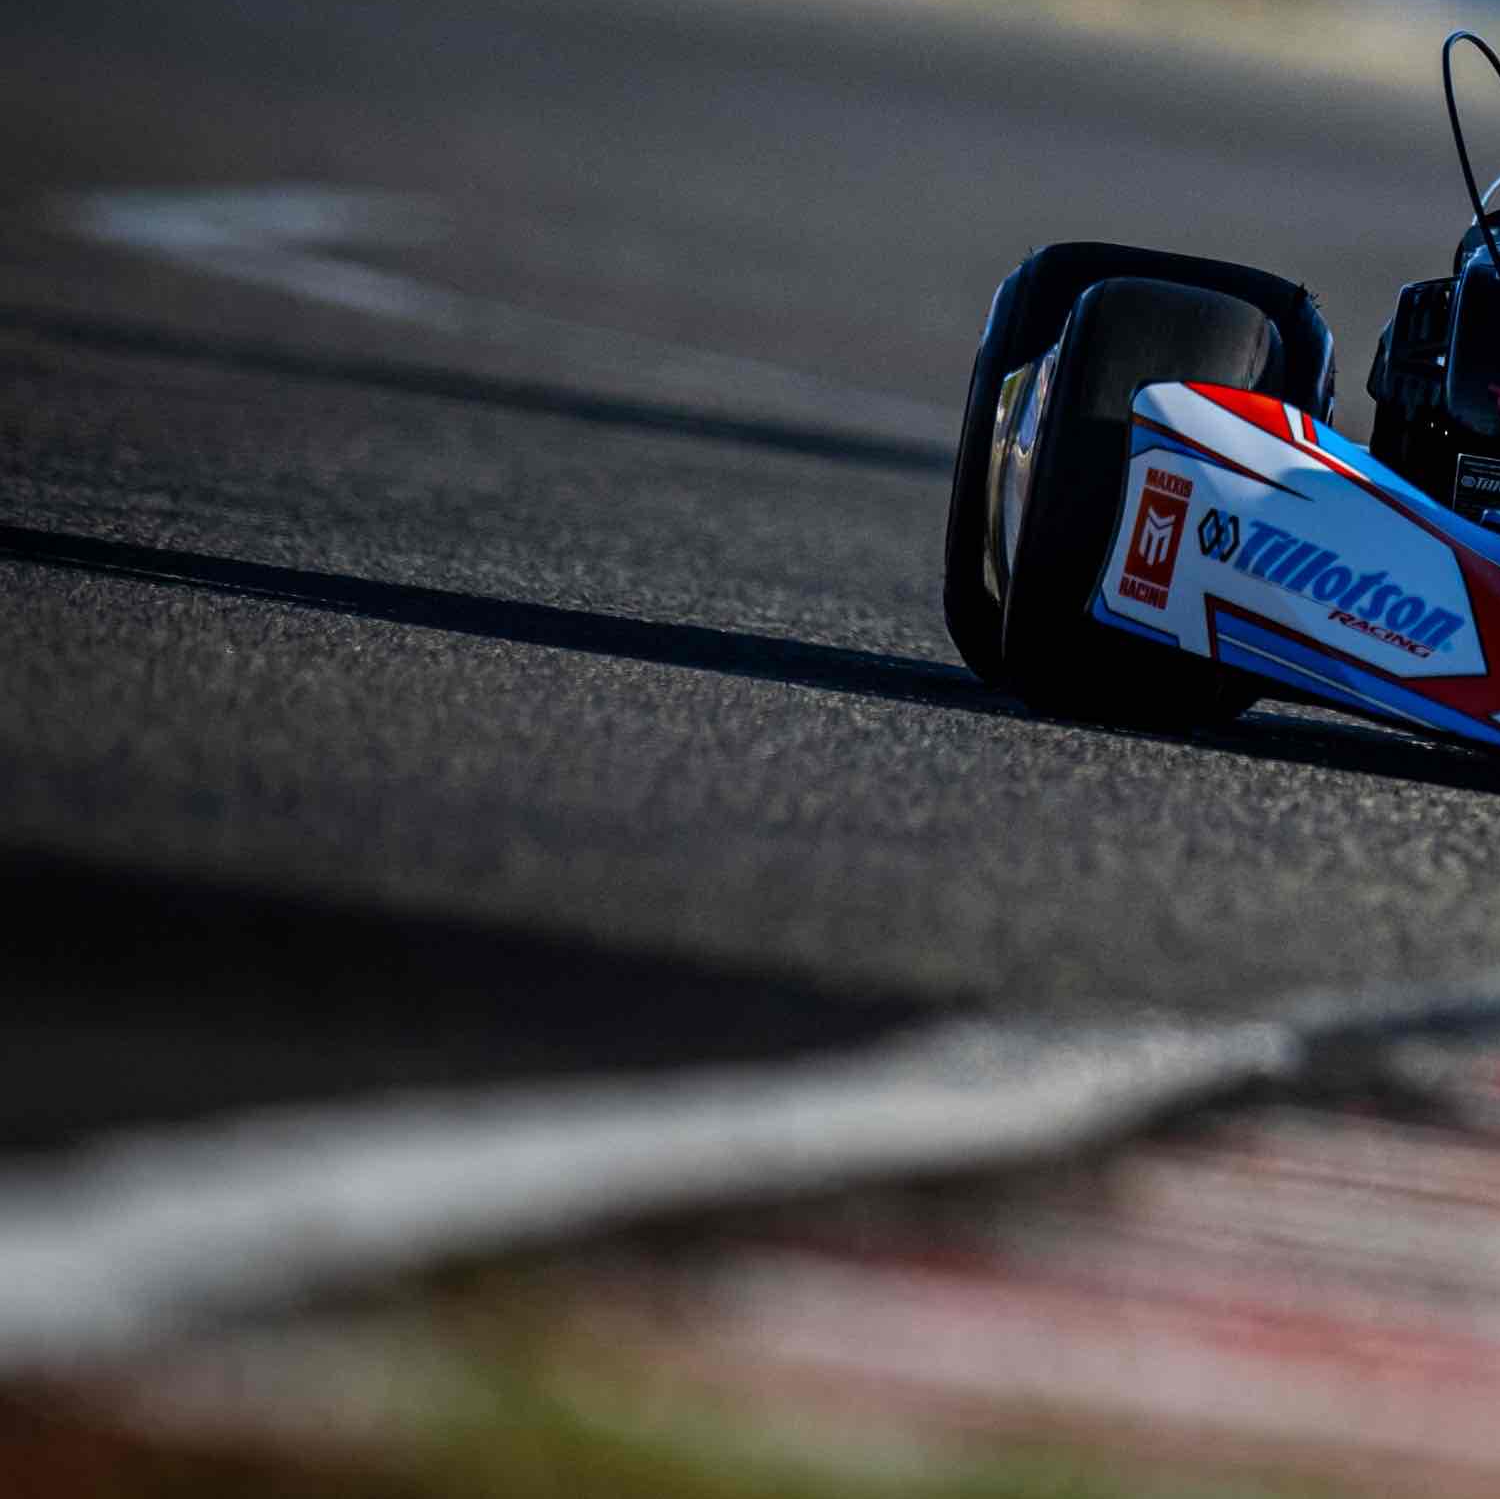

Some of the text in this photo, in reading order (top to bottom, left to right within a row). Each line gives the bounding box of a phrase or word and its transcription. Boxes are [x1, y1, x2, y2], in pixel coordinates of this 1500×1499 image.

[1146, 468, 1193, 497] MAXXIS
[1118, 575, 1168, 610] RACING
[1234, 519, 1466, 648] Tillotson
[1326, 607, 1433, 659] RACING
